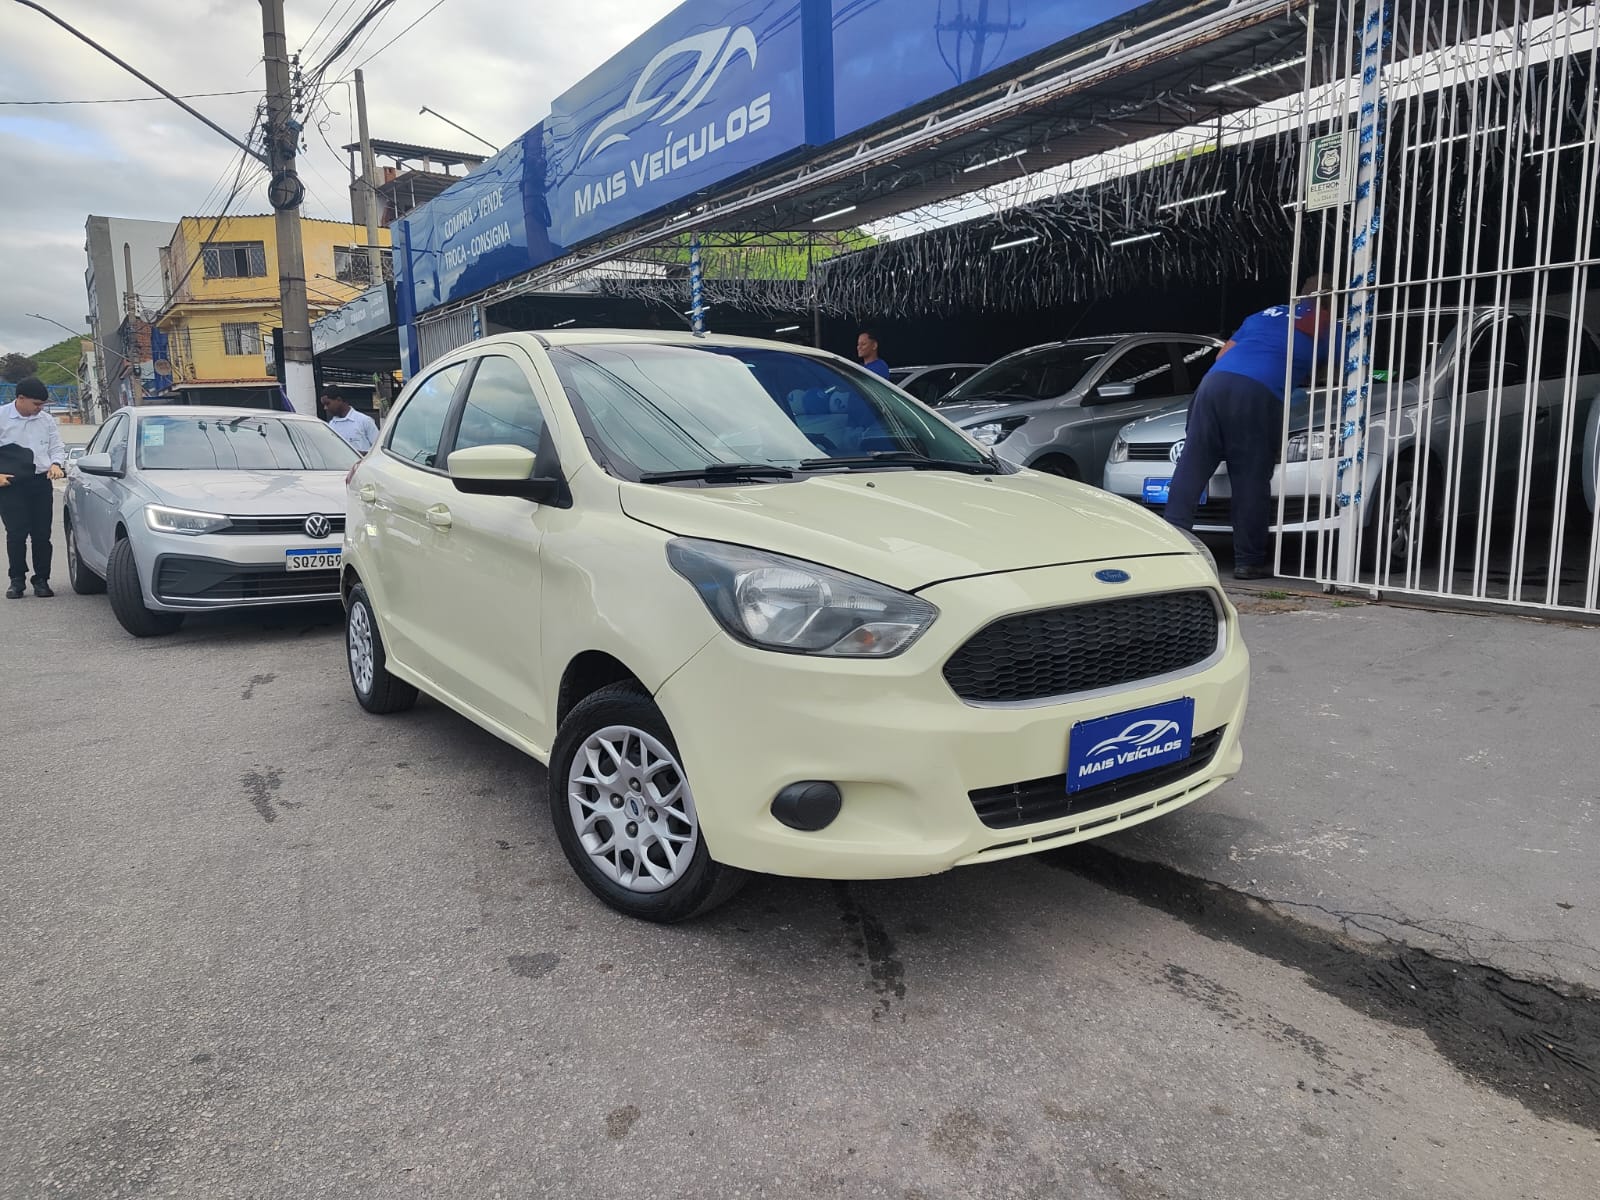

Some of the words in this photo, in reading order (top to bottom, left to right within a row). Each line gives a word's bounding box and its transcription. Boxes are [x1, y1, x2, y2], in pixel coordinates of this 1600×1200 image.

[574, 170, 627, 218] MAIS
[630, 92, 771, 189] VEÍCULOS
[444, 207, 474, 239] COMPRA
[477, 187, 504, 219] VENDE
[444, 244, 467, 271] TROCA
[471, 221, 511, 257] CONSIGNA
[1078, 757, 1114, 777] MAIS
[1117, 739, 1182, 765] VEÍCULOS
